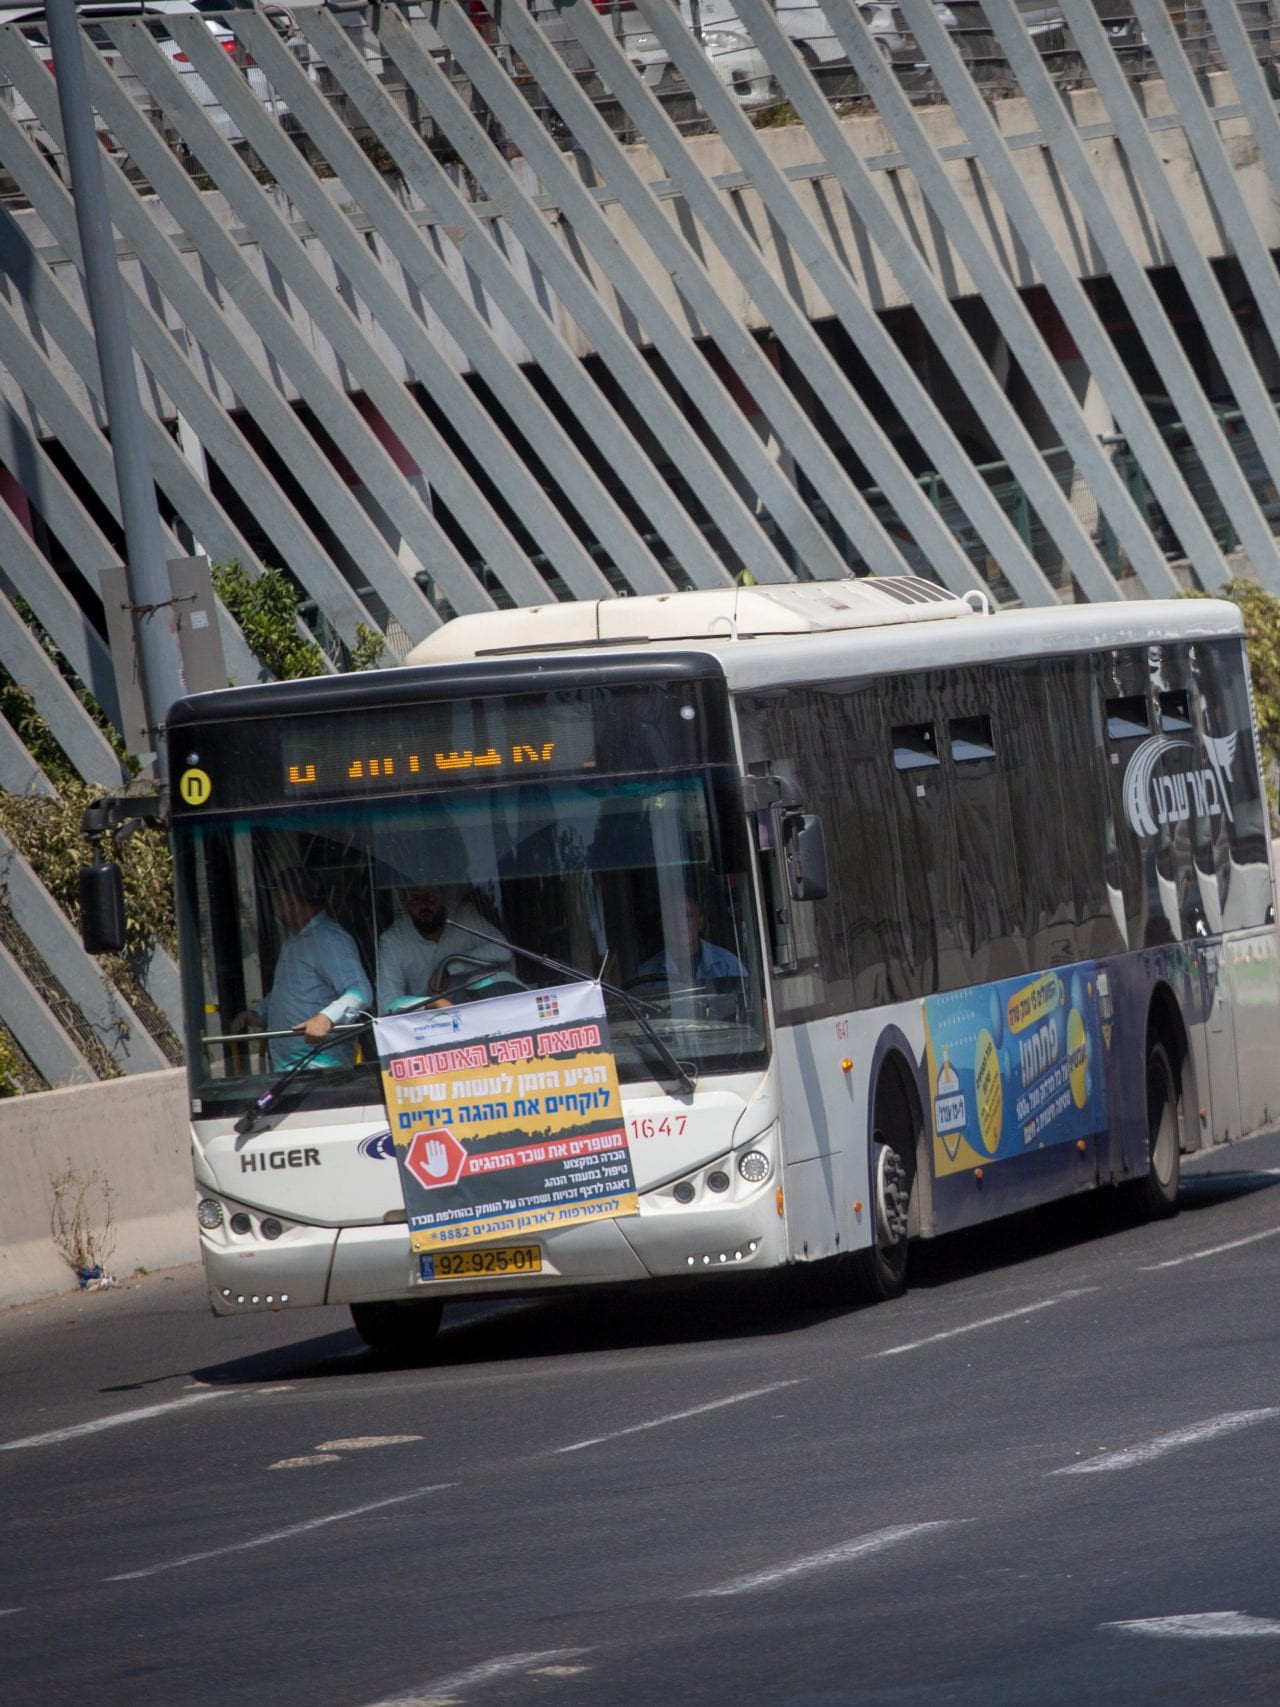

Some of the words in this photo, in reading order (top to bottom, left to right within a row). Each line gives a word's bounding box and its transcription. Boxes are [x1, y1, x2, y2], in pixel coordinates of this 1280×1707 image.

[1152, 773, 1190, 824] שבע
[1186, 769, 1221, 817] באר
[489, 1036, 534, 1063] נהגי
[537, 1024, 601, 1056] מחאת
[390, 1044, 488, 1080] האוטובוס
[1019, 1018, 1058, 1088] פתחנו!
[518, 1071, 560, 1097] הזמן
[564, 1064, 608, 1087] הגיע
[451, 1076, 514, 1099] לעשות
[514, 1096, 540, 1116] את
[545, 1086, 610, 1115] לוקחים
[398, 1108, 454, 1130] בידיים
[459, 1101, 508, 1123] ההגה
[630, 1115, 688, 1140] 1647
[547, 1144, 567, 1159] את
[570, 1133, 623, 1155] משפרים
[240, 1148, 322, 1173] HIGER
[469, 1151, 516, 1173] הנהגים
[520, 1147, 546, 1164] שכר
[563, 1154, 599, 1171] במקצוע
[600, 1150, 626, 1164] הכרה
[569, 1170, 601, 1184] במעמד
[601, 1163, 628, 1179] טיפול
[544, 1176, 568, 1189] הנהג
[579, 1182, 605, 1198] לרצף
[606, 1179, 631, 1192] דאגה
[502, 1198, 517, 1210] על
[518, 1193, 552, 1208] ושמירה
[553, 1188, 578, 1203] זכויות
[411, 1212, 435, 1227] מכרז
[436, 1206, 475, 1222] בהחלפת
[475, 1200, 502, 1218] הוותק
[516, 1209, 556, 1230] לארגון
[558, 1199, 621, 1220] להצטרפות
[473, 1218, 514, 1235] הנהגים
